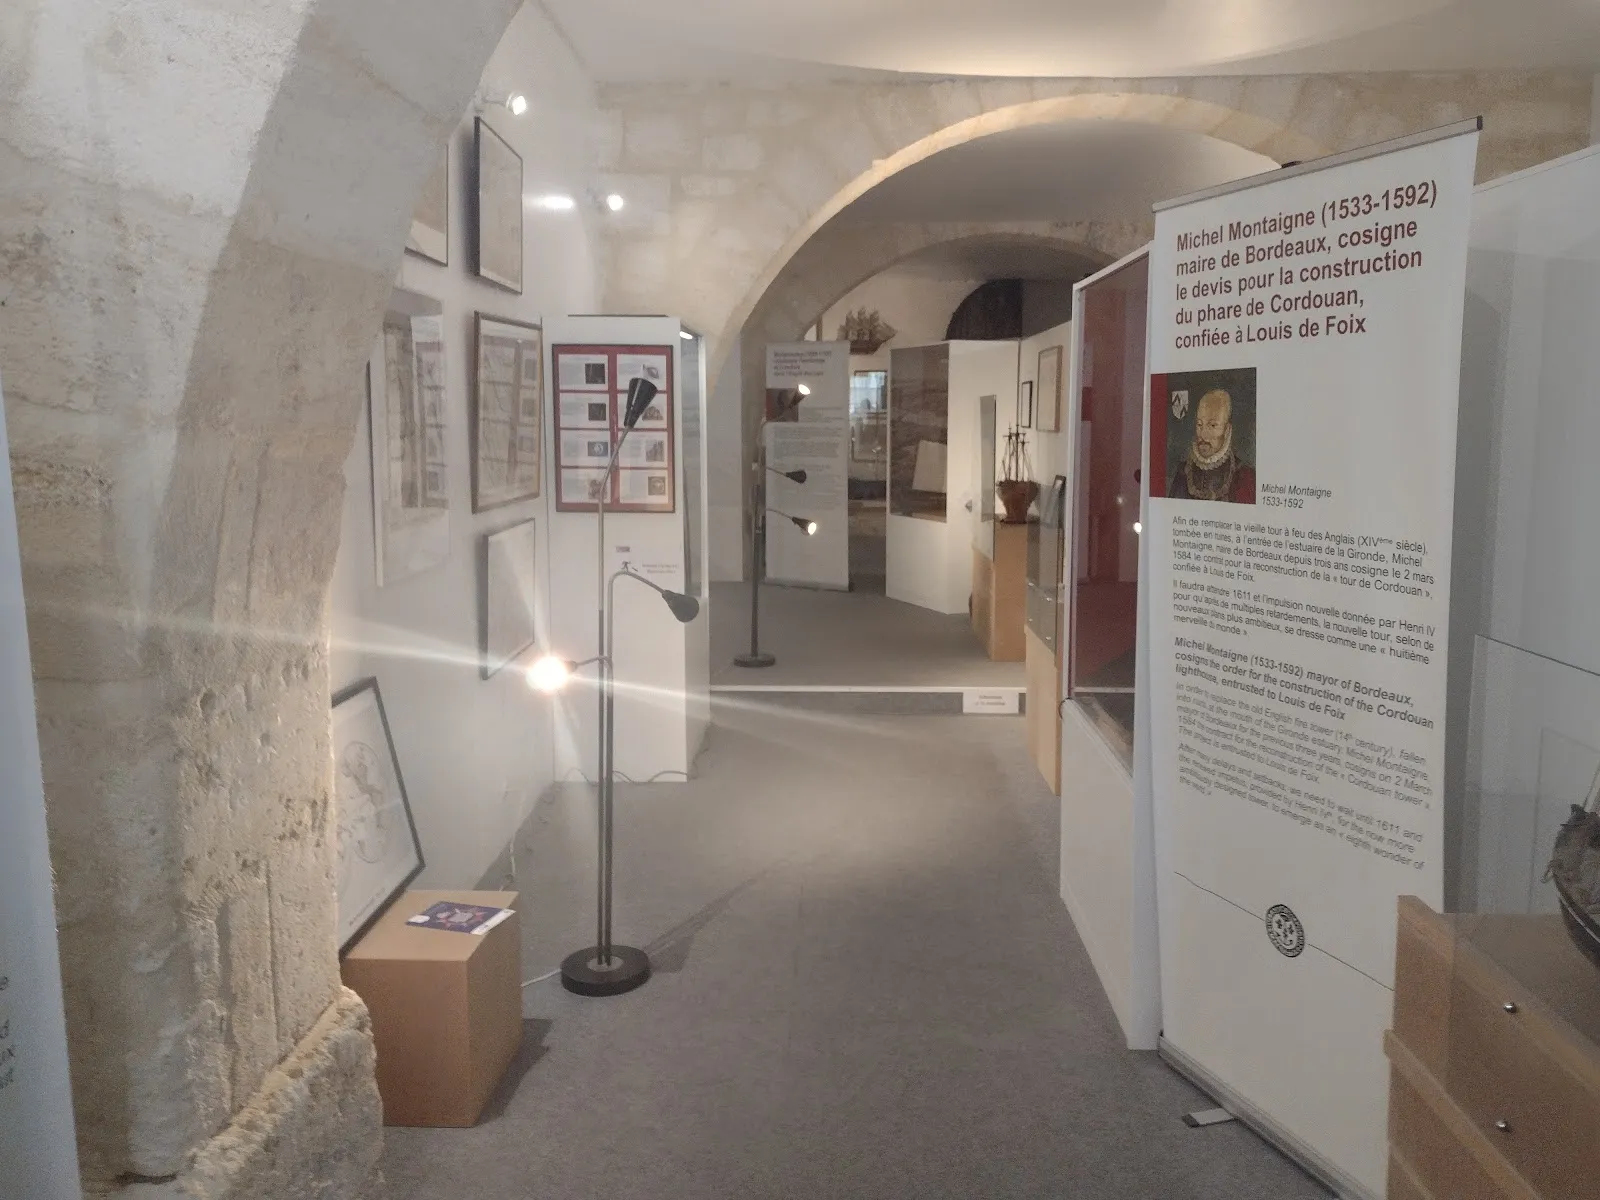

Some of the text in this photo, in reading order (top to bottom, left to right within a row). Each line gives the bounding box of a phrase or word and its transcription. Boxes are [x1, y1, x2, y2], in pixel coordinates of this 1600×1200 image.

[1177, 180, 1438, 252] Michel Montaigne (1533-1592)
[1176, 220, 1418, 276] maire de Bordeaux, cosigne
[1176, 250, 1422, 300] le devis pour la construction
[1176, 289, 1364, 327] du phare de Cordouan,
[1176, 313, 1366, 348] confiée à Louis de Foix
[1261, 484, 1332, 498] Michel Montaigne
[1262, 496, 1304, 508] 1533-1592
[1172, 516, 1186, 526] Afin
[1189, 518, 1198, 526] de
[1234, 522, 1241, 531] la
[1244, 523, 1266, 534] vieille
[1268, 526, 1282, 536] tour
[1284, 526, 1290, 536] à
[1292, 528, 1305, 538] feu
[1308, 530, 1322, 540] des
[1324, 532, 1354, 545] Anglais
[1172, 528, 1201, 538] tombée
[1236, 534, 1240, 544] à
[1243, 535, 1272, 547] l'entrée
[1274, 540, 1283, 548] de
[1285, 540, 1322, 554] l'estuaire
[1324, 545, 1335, 556] de
[1338, 546, 1344, 557] la
[1347, 548, 1388, 564] Gironde,
[1392, 553, 1422, 567] Michel
[1172, 562, 1200, 572] confiée
[1204, 565, 1208, 574] à
[1225, 570, 1234, 579] de
[1174, 550, 1192, 560] 1584
[1224, 558, 1241, 569] pour
[1244, 560, 1250, 570] la
[1252, 562, 1308, 578] reconstruction
[1310, 570, 1320, 580] de
[1323, 572, 1330, 582] la
[1340, 576, 1356, 586] tour
[1358, 578, 1370, 588] de
[1374, 580, 1422, 597] Cordouan
[1233, 546, 1244, 556] de
[1246, 548, 1282, 561] Bordeaux
[1284, 554, 1312, 566] depuis
[1314, 558, 1332, 568] trois
[1334, 561, 1348, 572] ans
[1351, 564, 1388, 578] cosigne
[1392, 568, 1400, 579] le
[1404, 569, 1410, 580] 2
[1412, 572, 1434, 584] mars
[1174, 592, 1190, 602] pour
[1221, 600, 1229, 608] de
[1230, 603, 1264, 616] multiples
[1266, 610, 1320, 628] retardements,
[1323, 619, 1331, 630] la
[1332, 622, 1368, 638] nouvelle
[1370, 630, 1392, 643] tour,
[1396, 635, 1422, 648] selon
[1424, 640, 1434, 652] de
[1174, 614, 1208, 627] merveille
[1216, 623, 1240, 635] monde
[1180, 580, 1204, 592] faudra
[1233, 590, 1251, 600] 1611
[1253, 594, 1260, 602] et
[1262, 594, 1304, 610] l'impulsion
[1306, 604, 1340, 618] nouvelle
[1342, 610, 1376, 625] donnée
[1379, 618, 1396, 628] par
[1399, 620, 1424, 634] Henri
[1426, 625, 1436, 636] IV
[1226, 612, 1243, 624] plus
[1284, 626, 1294, 635] se
[1296, 628, 1325, 640] dresse
[1326, 634, 1356, 648] comme
[1358, 642, 1376, 654] une
[1390, 647, 1430, 664] huitième
[1174, 636, 1205, 650] Michel
[1250, 654, 1304, 680] (1533-1592)
[1306, 671, 1339, 686] mayor
[1341, 680, 1352, 690] of
[1354, 682, 1414, 707] Bordeaux,
[1222, 663, 1246, 677] order
[1248, 668, 1262, 680] for
[1264, 674, 1278, 686] the
[1280, 679, 1342, 704] construction
[1344, 696, 1354, 706] of
[1356, 700, 1374, 712] the
[1377, 704, 1434, 730] Cordouan
[1222, 678, 1266, 696] entrusted
[1267, 690, 1276, 700] to
[1278, 692, 1306, 709] Louis
[1308, 701, 1322, 712] de
[1324, 704, 1346, 720] Foix
[1264, 708, 1292, 724] English
[1395, 776, 1402, 786] 2
